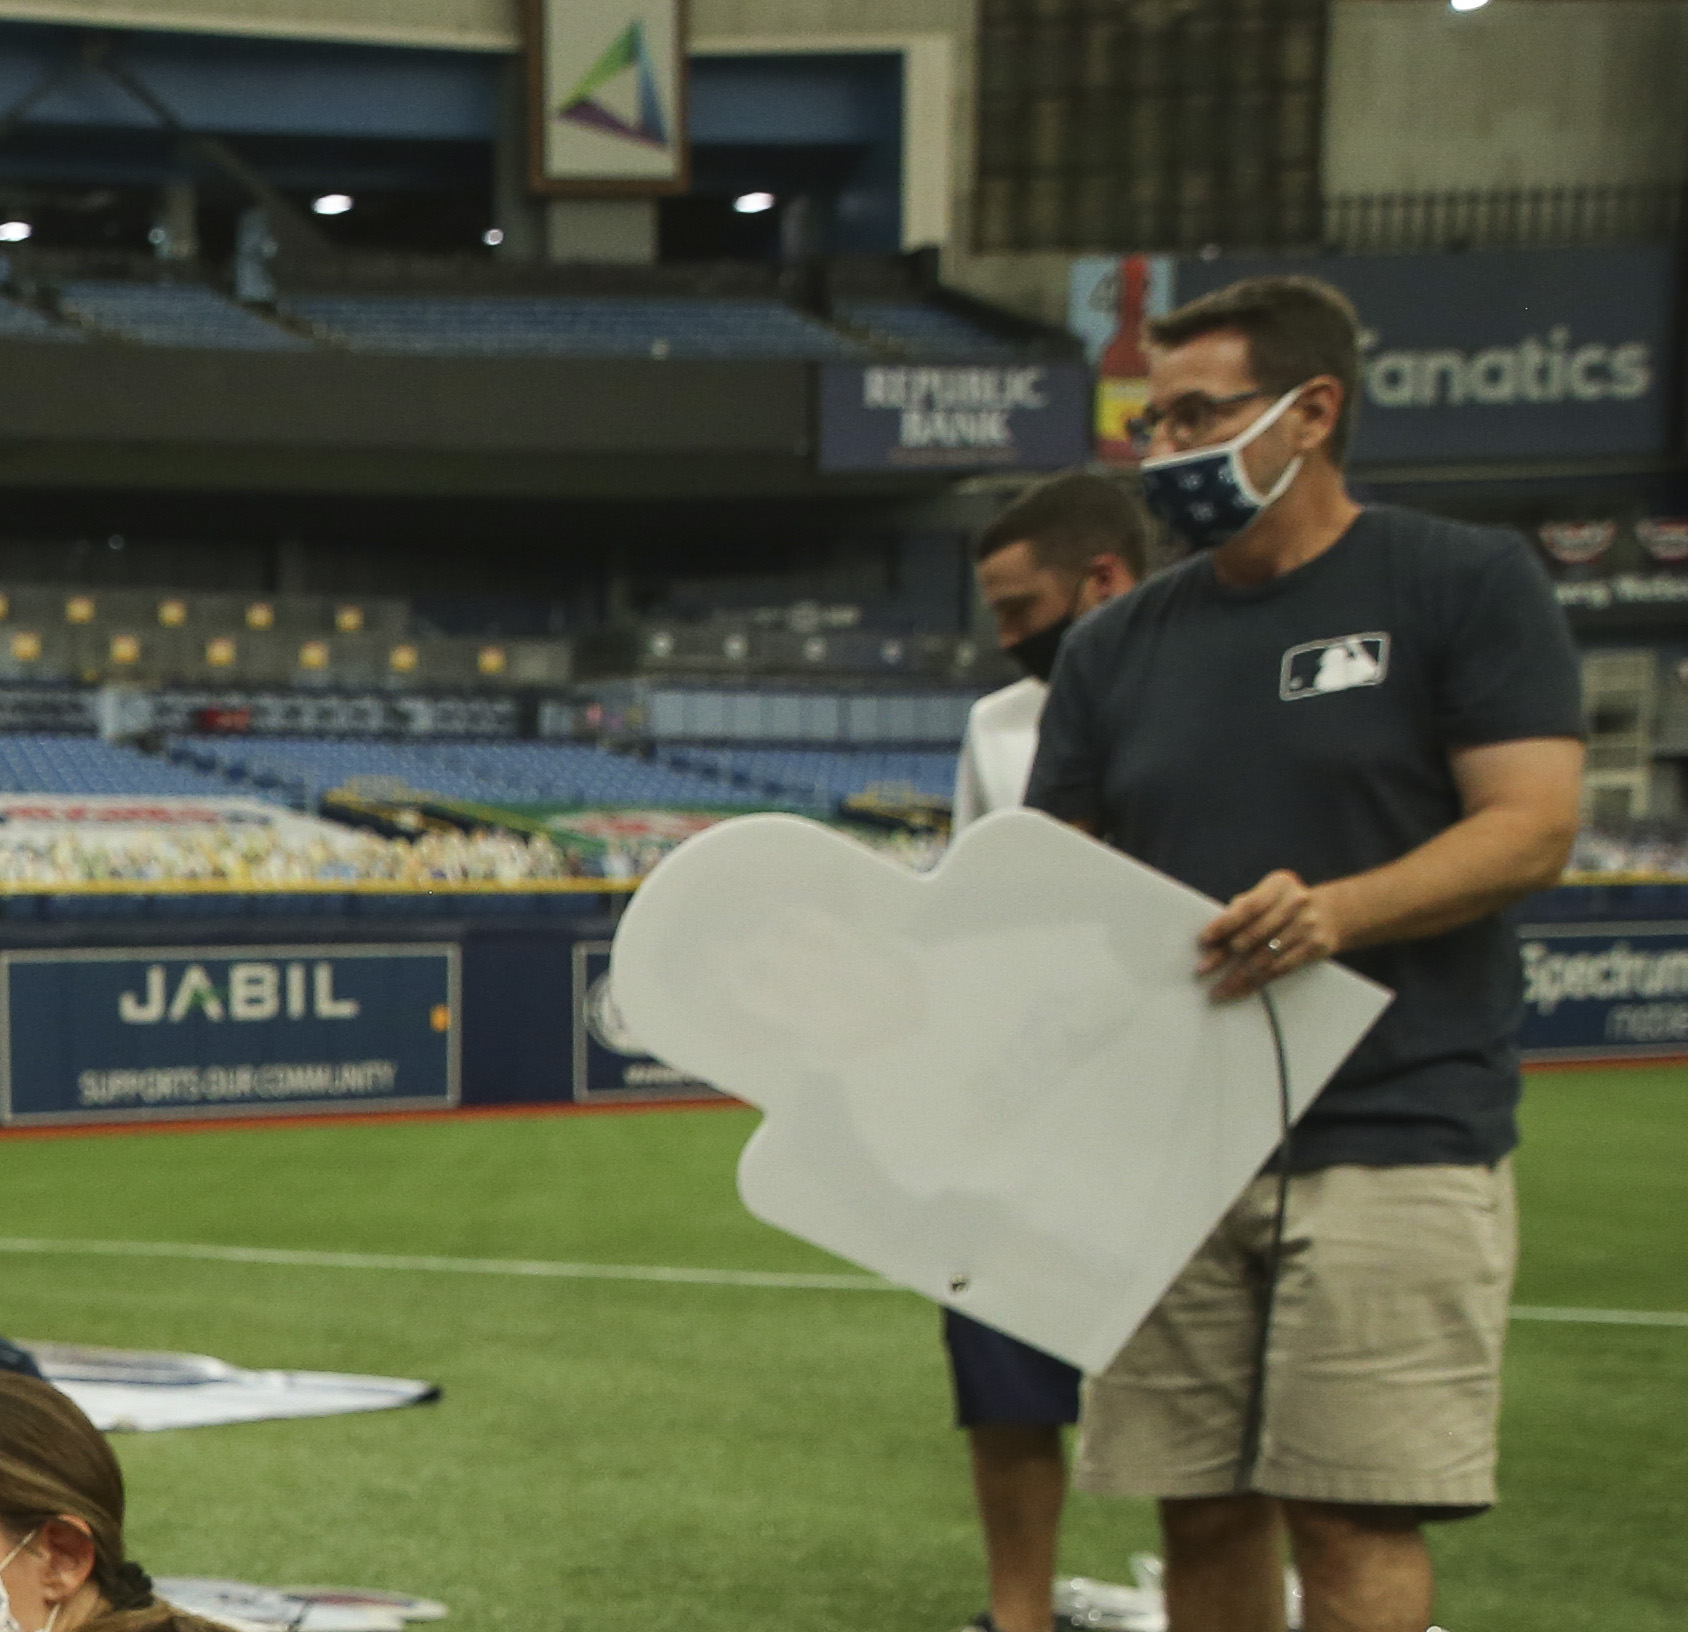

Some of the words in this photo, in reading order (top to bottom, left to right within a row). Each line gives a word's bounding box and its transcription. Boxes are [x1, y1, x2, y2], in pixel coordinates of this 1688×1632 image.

[864, 364, 1048, 409] REPUBLIC
[1355, 323, 1652, 408] anatics
[899, 408, 1016, 448] BANK
[119, 963, 361, 1024] JABIL
[78, 1066, 200, 1105] SUPPORTS
[203, 1064, 255, 1101] OUR
[258, 1059, 397, 1100] COMMUNITY
